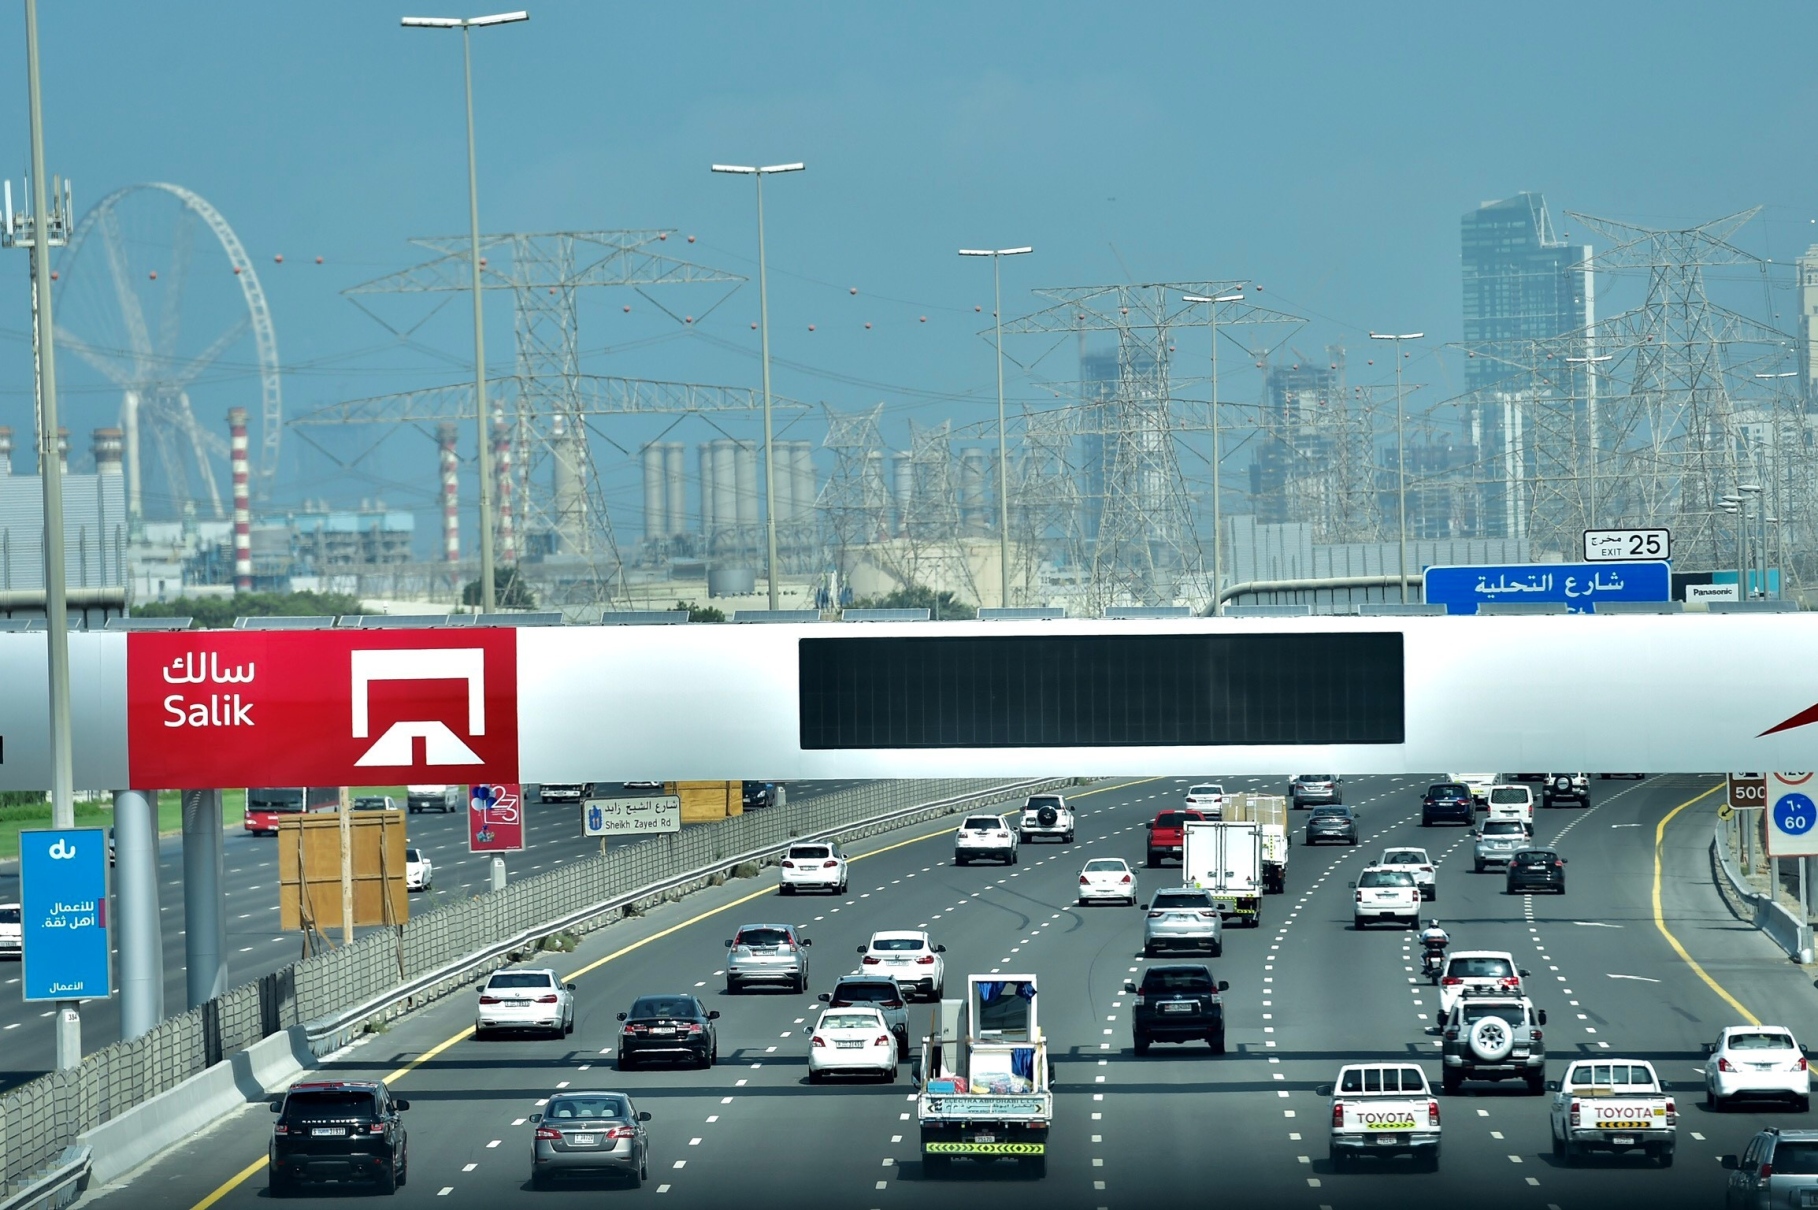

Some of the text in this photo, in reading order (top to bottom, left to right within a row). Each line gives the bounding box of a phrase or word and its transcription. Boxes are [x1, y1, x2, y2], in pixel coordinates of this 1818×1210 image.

[1591, 534, 1621, 546] مخرج
[1629, 534, 1661, 555] 25
[1601, 548, 1622, 556] EXIT
[1475, 571, 1625, 599] شارع التحلية
[1693, 588, 1733, 597] Panasonic
[163, 651, 255, 684] سالك
[163, 693, 255, 728] Salik
[604, 800, 678, 815] شارع الشيخ زايد
[605, 817, 671, 830] Sheikh Zayed Rd
[1784, 815, 1806, 829] 60
[49, 838, 76, 860] du
[69, 913, 95, 929] أهل
[1357, 1112, 1416, 1124] TOYOTA
[1594, 1107, 1653, 1119] TOYOTA
